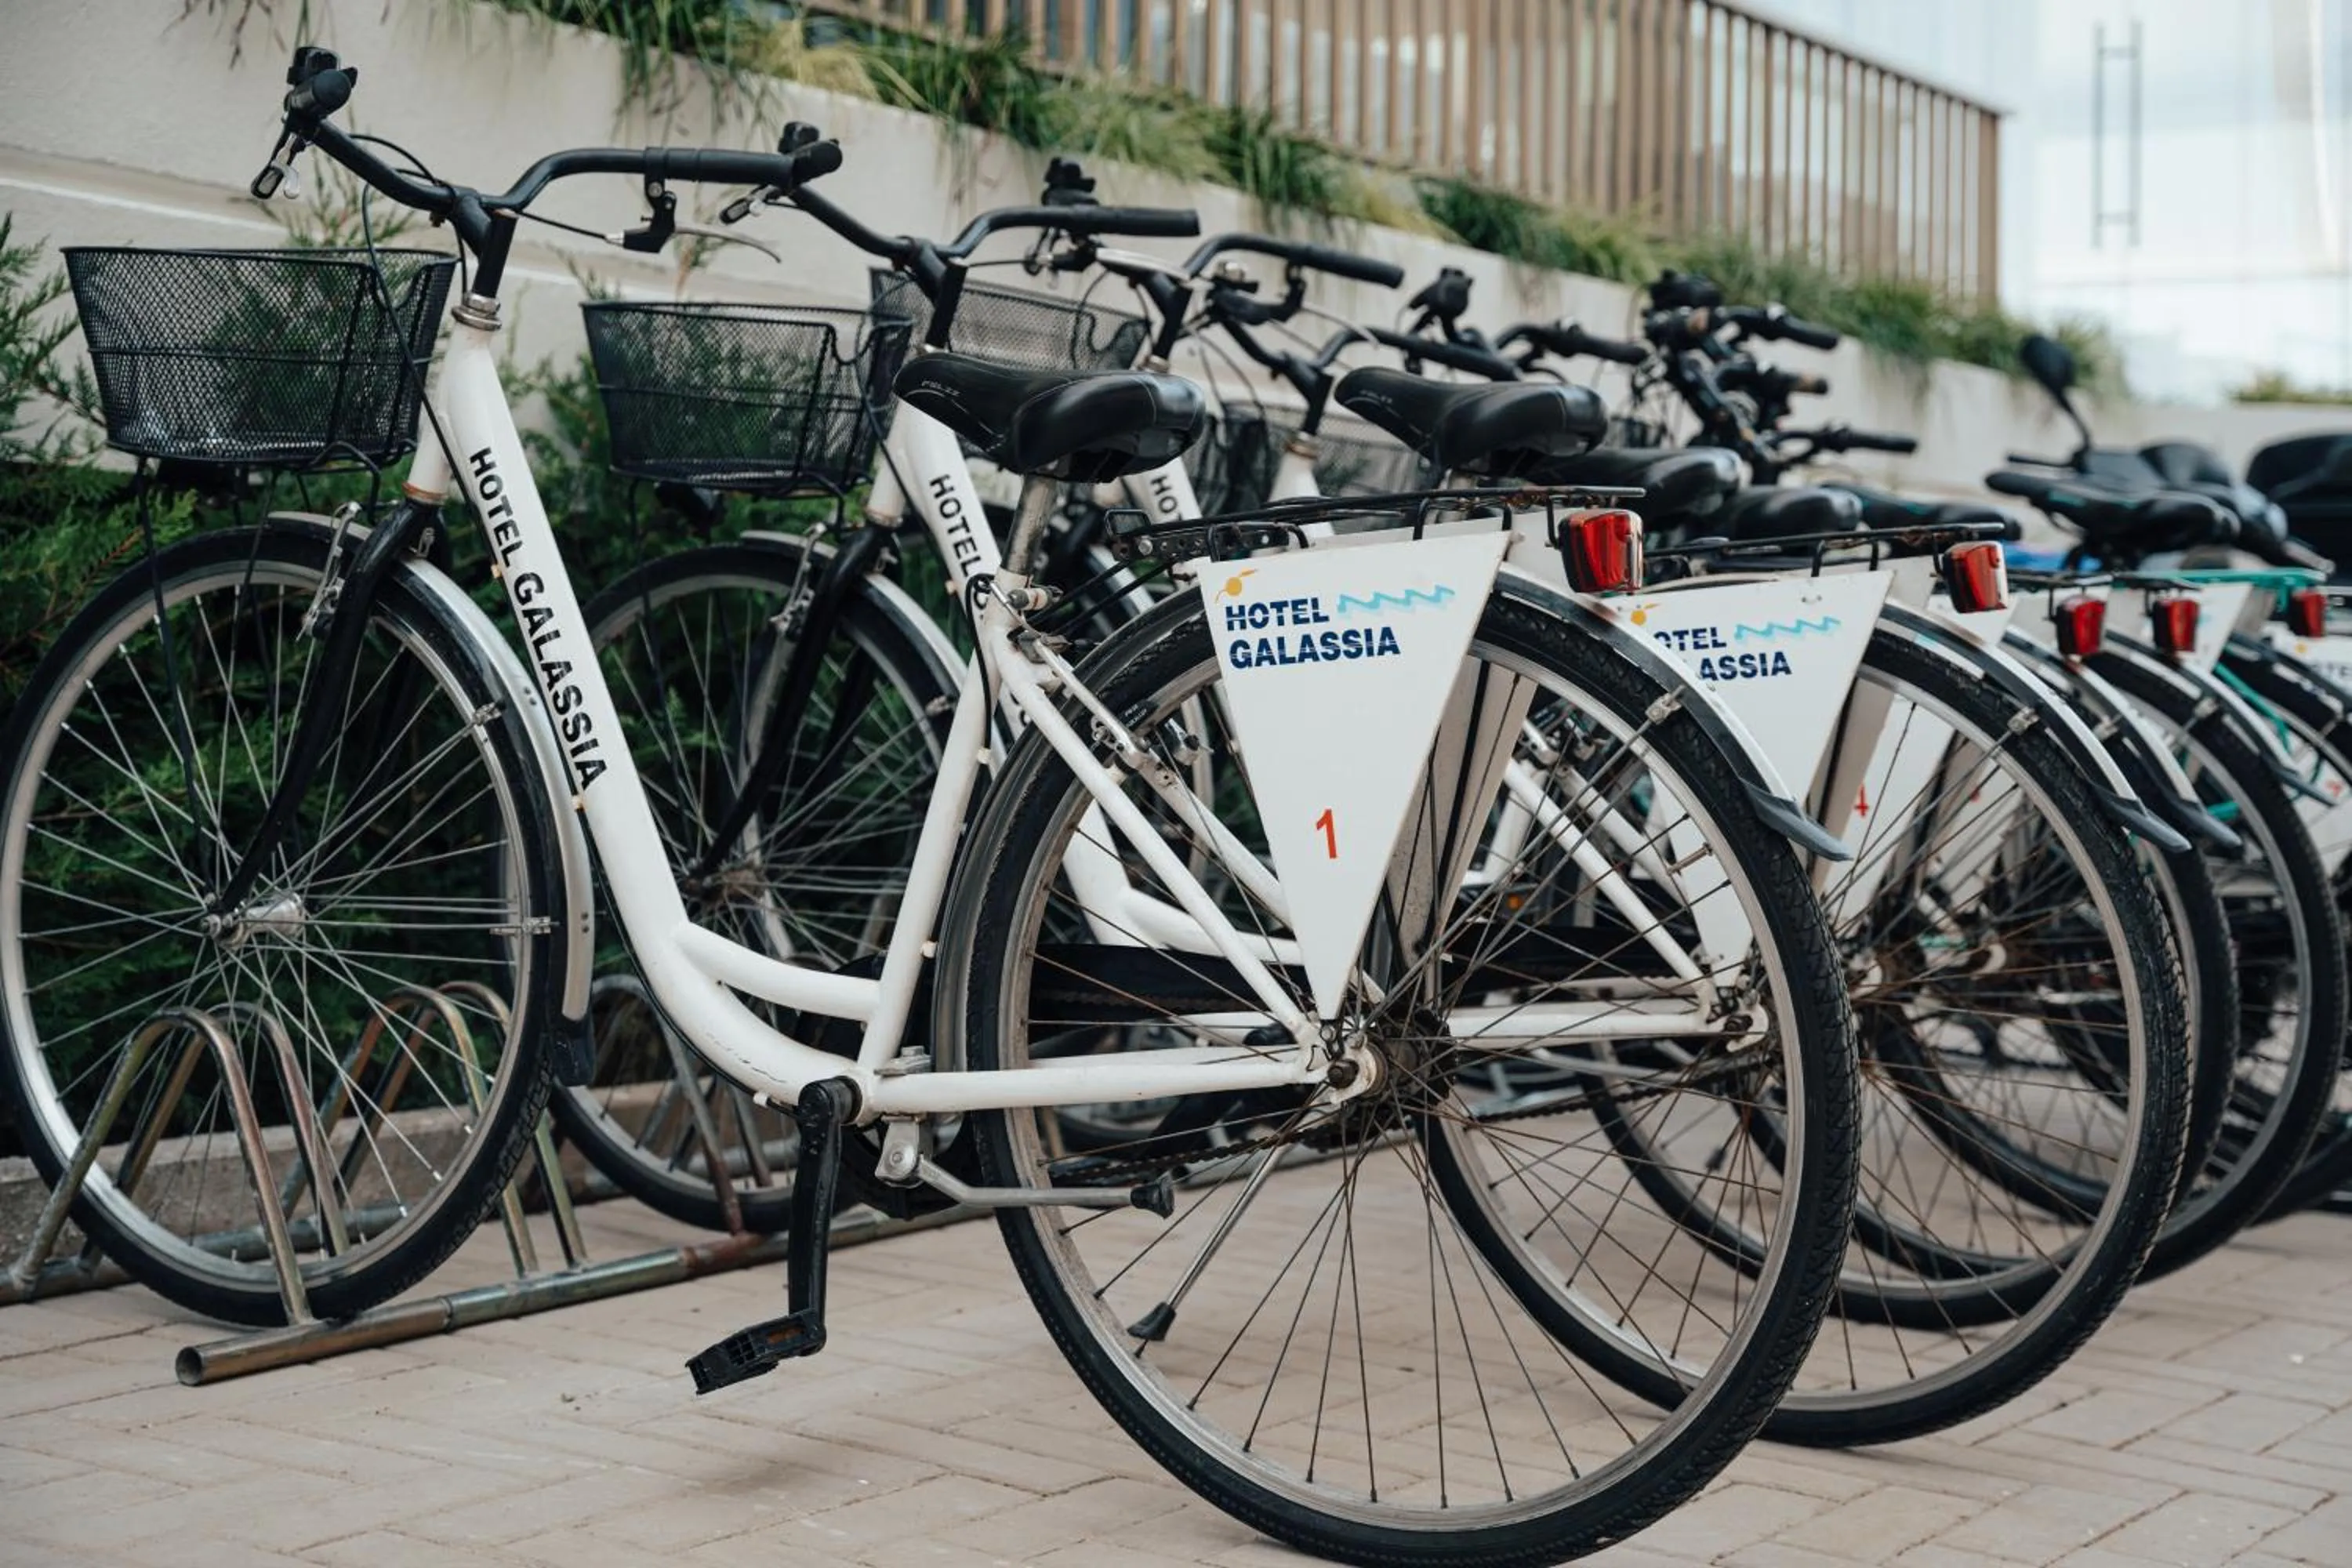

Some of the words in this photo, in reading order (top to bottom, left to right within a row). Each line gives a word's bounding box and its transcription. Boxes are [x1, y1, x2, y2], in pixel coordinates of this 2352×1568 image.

[930, 474, 982, 577] HOTEL
[470, 448, 522, 568] HOTEL
[514, 572, 607, 790] GALASSIA
[1225, 597, 1330, 630] HOTEL
[1230, 626, 1401, 669] GALASSIA
[1653, 627, 1727, 652] OTEL
[1700, 651, 1792, 681] ASSIA
[1316, 808, 1338, 859] 1
